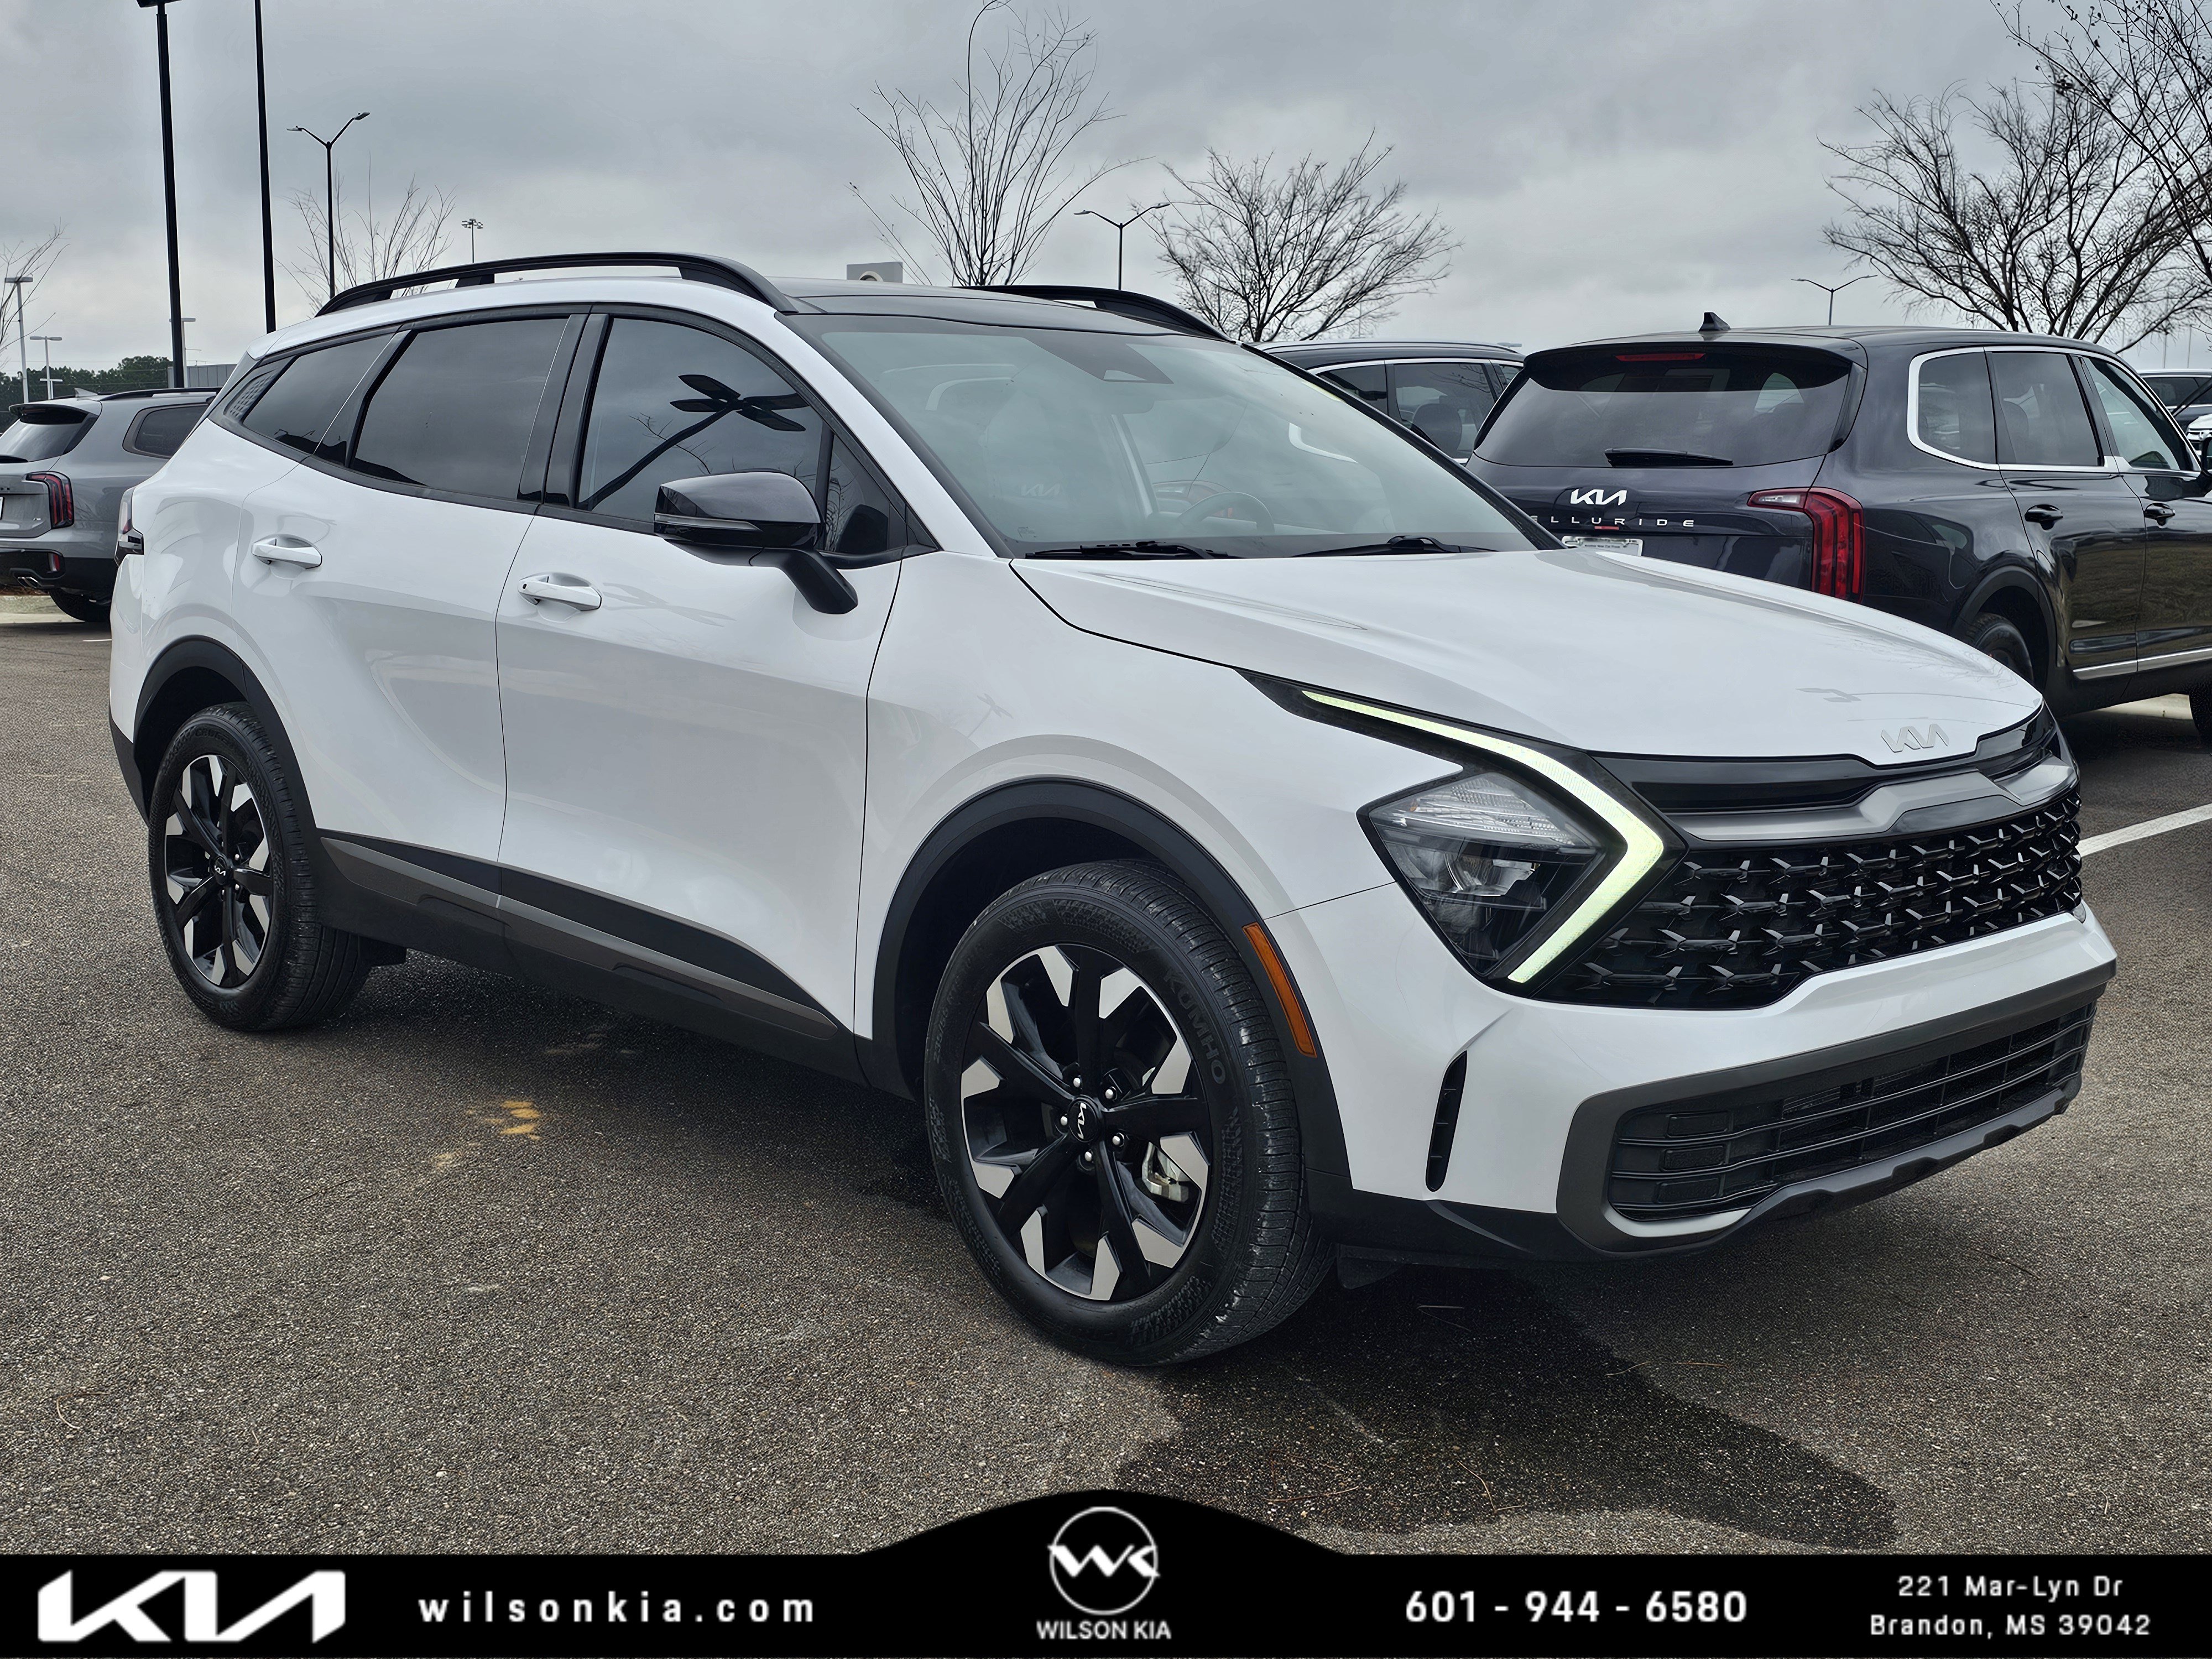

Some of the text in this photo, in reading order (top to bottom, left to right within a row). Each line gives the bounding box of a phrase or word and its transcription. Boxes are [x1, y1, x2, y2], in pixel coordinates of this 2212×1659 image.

[1570, 489, 1627, 505] KIA
[1881, 723, 1949, 753] KIA
[1164, 968, 1226, 1084] KUMHO
[1077, 1102, 1087, 1139] KIA
